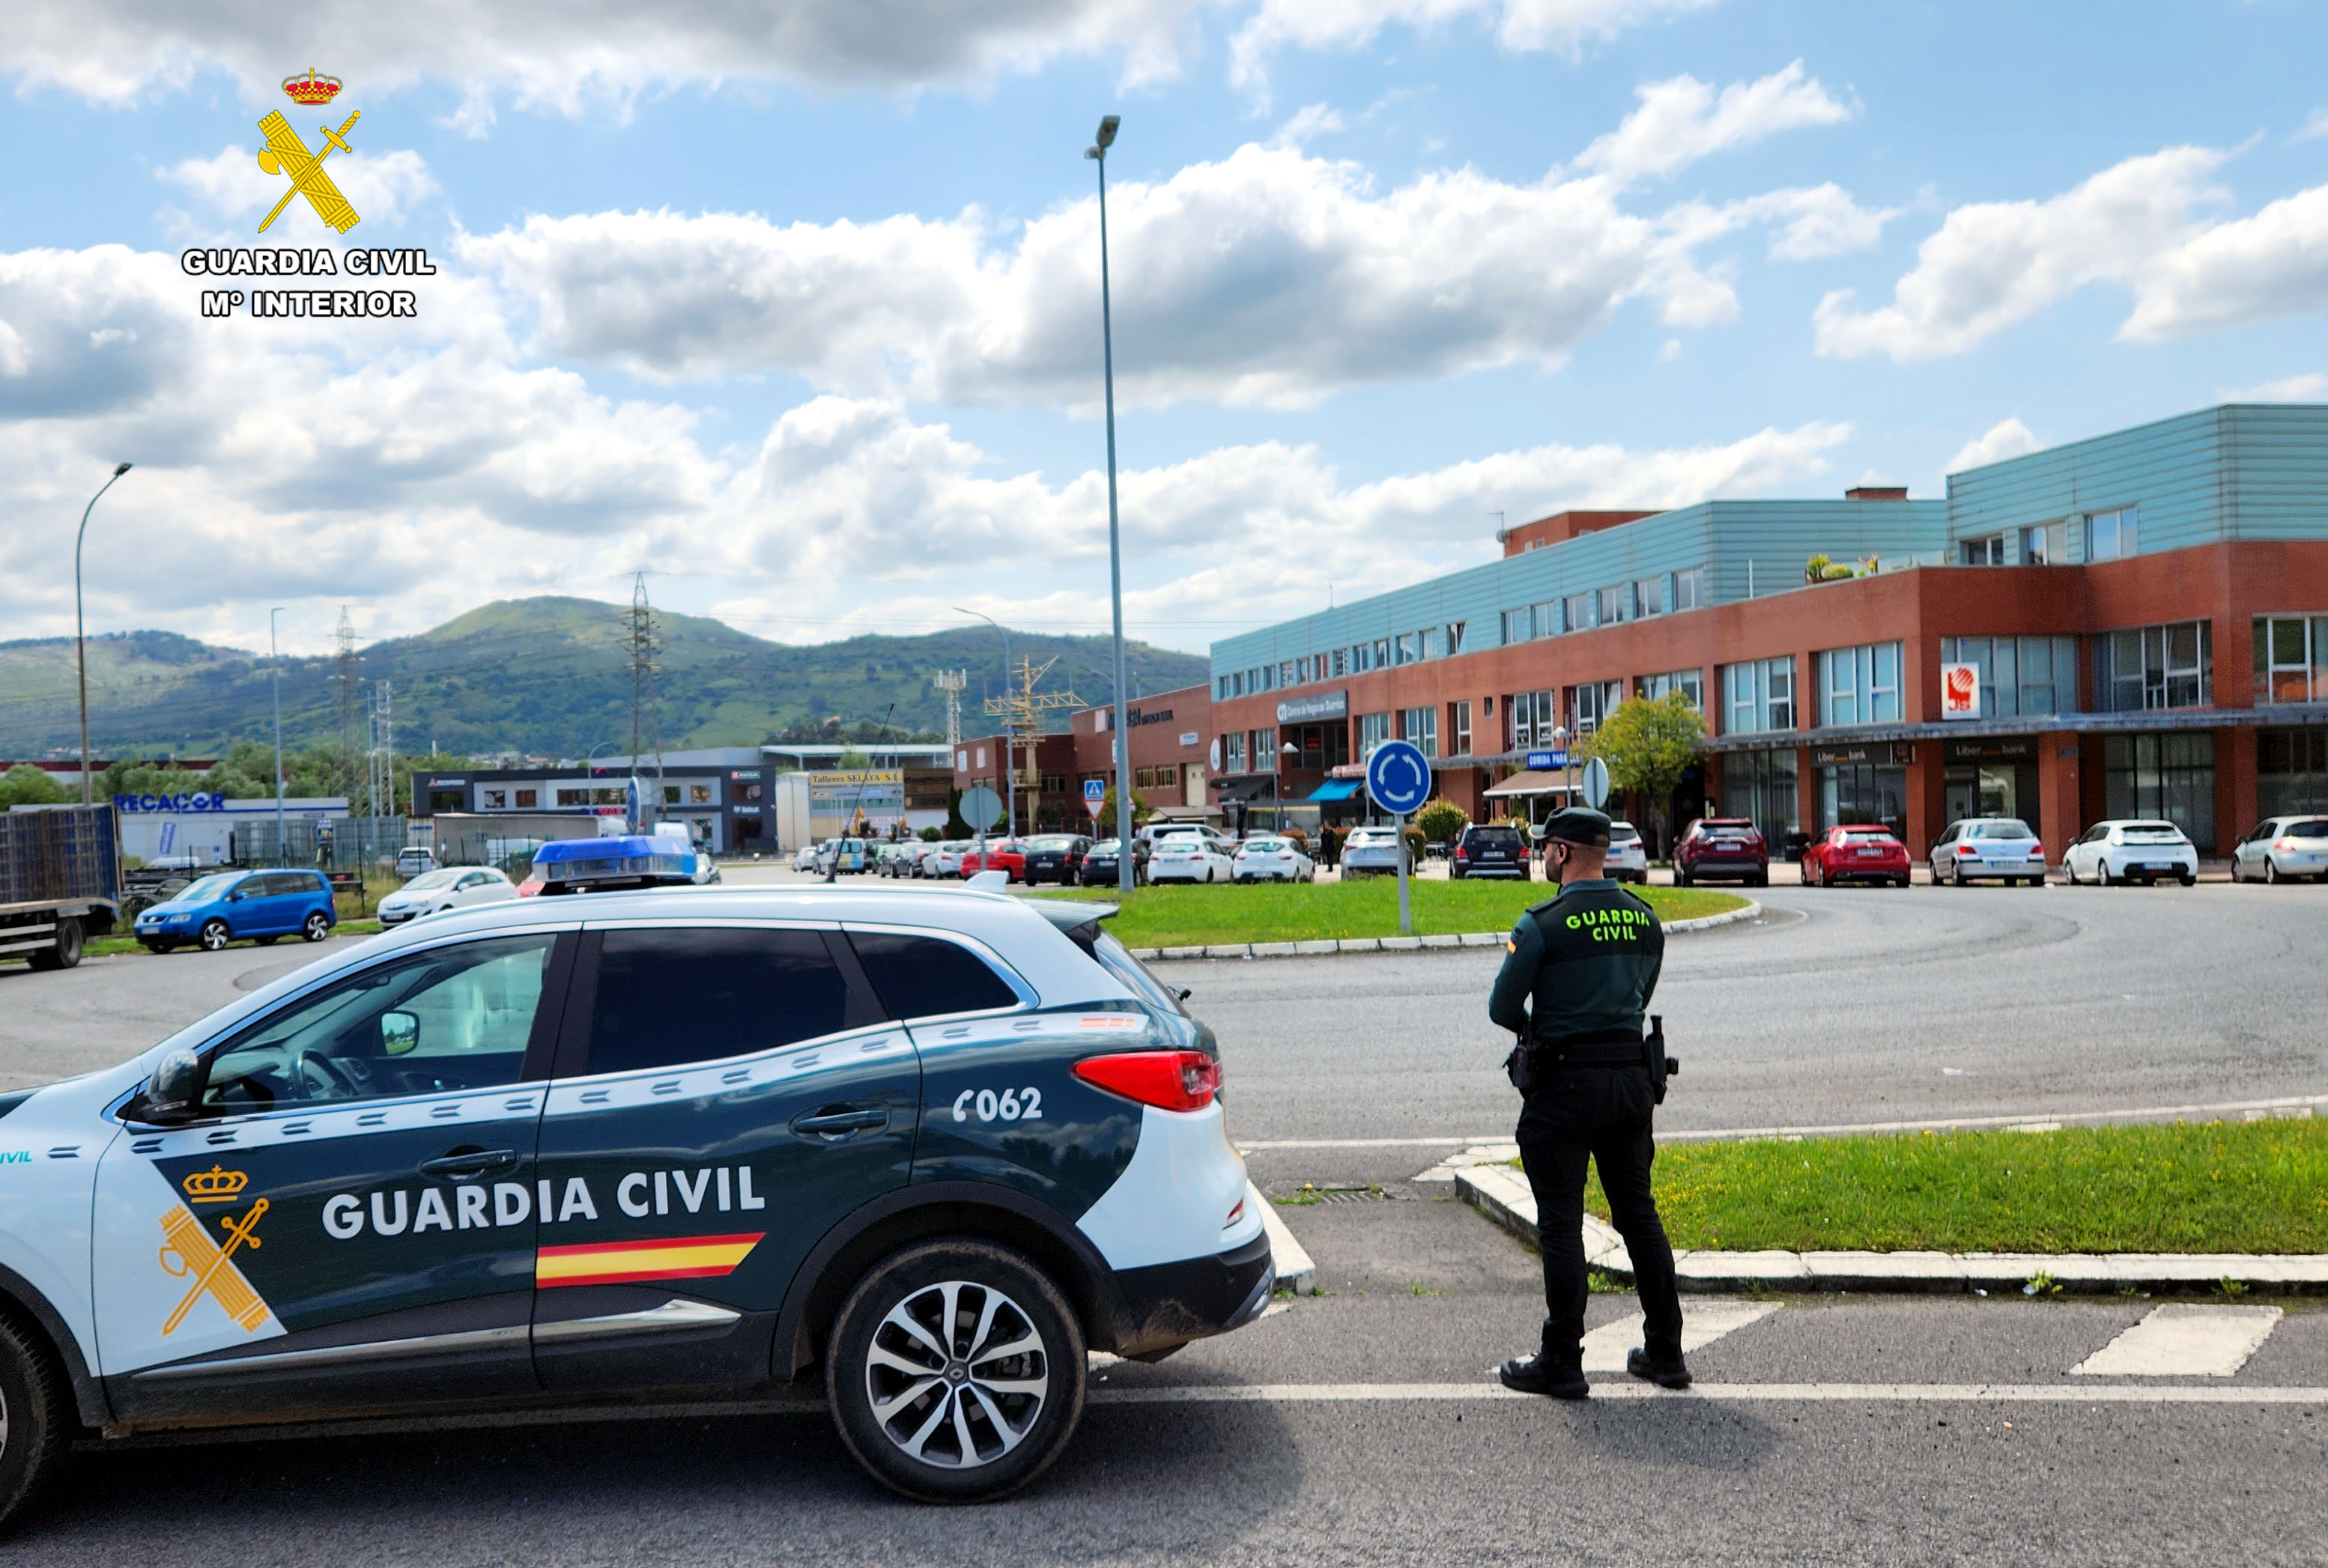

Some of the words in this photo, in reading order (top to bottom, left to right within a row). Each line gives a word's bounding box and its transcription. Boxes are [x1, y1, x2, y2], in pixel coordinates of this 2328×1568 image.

[1529, 754, 1551, 767] COMIDA
[813, 775, 844, 784] Talleres
[847, 774, 880, 783] SELAYA
[113, 791, 225, 811] RECACOR
[1565, 909, 1650, 929] GUARDIA
[1592, 926, 1637, 941] CIVIL
[975, 1087, 1043, 1122] 062
[322, 1176, 598, 1240] GUARDIA
[616, 1165, 766, 1218] CIVIL
